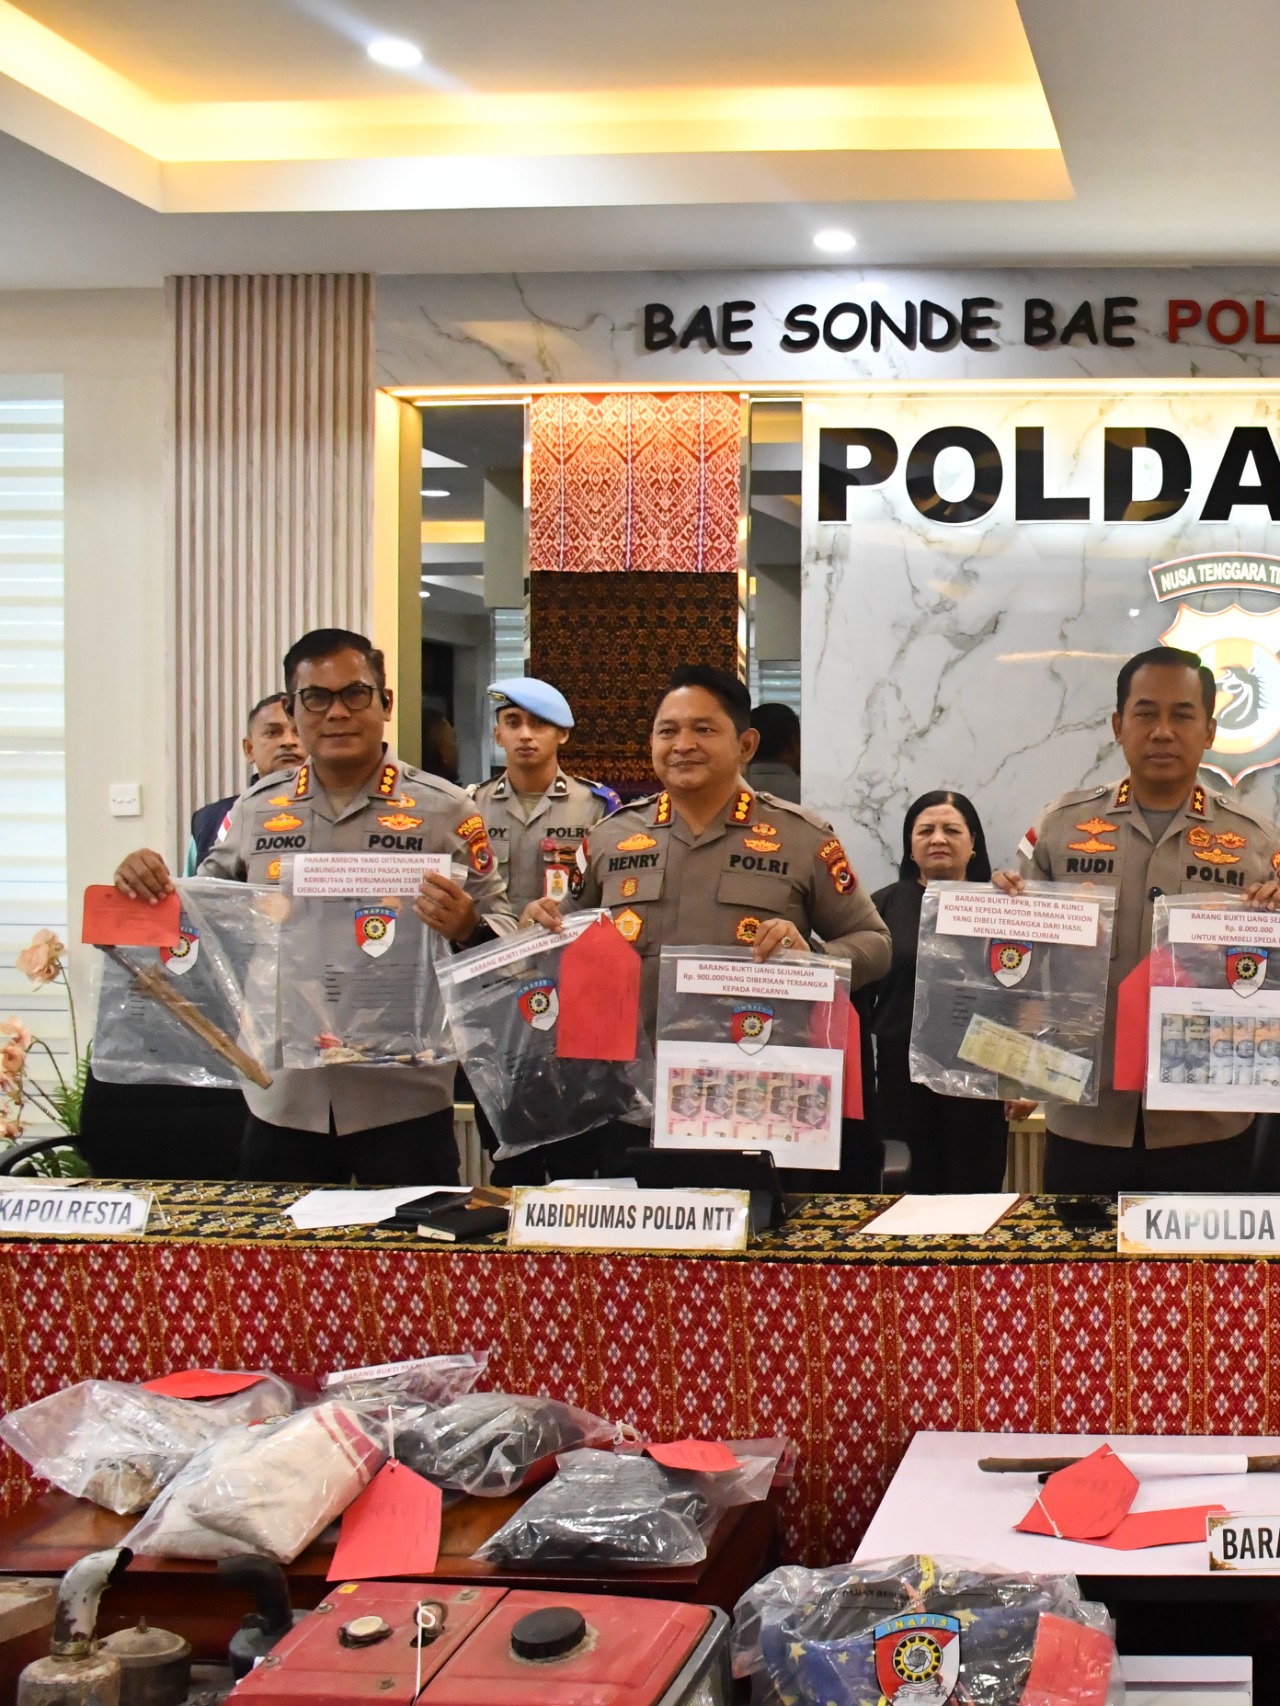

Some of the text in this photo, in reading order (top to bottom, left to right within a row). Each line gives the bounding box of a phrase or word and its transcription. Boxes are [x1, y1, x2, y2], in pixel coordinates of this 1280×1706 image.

[644, 300, 756, 350] BAE
[782, 297, 996, 351] SONDE
[1024, 297, 1138, 348] BAE
[1160, 566, 1197, 592] NUSA
[1197, 562, 1266, 583] TENGGARA
[488, 827, 507, 838] OY
[256, 835, 306, 850] DJOKO
[368, 835, 422, 851] POLRI
[608, 853, 660, 872] HENRY
[729, 854, 789, 875] POLRI
[1066, 857, 1114, 874] RUDI
[1186, 864, 1245, 887] POLRI
[955, 895, 986, 904] BARANG
[987, 897, 1009, 905] BUKTI
[1032, 900, 1052, 908] STNK
[1061, 903, 1084, 911] KUNCI
[944, 904, 973, 913] KONTAK
[975, 906, 1002, 915] SEPEDA
[1003, 909, 1031, 917] MOTOR
[1032, 911, 1065, 920] YAMAHA
[1191, 913, 1222, 921] BARANG
[1247, 915, 1268, 923] UANG
[952, 915, 1082, 932] YANG DIBELI TERSANGKA DARI HASIL
[973, 927, 1060, 940] MENJUAL EMAS CURIAN
[1218, 935, 1252, 943] MEMBELI
[1253, 936, 1277, 944] SPEDA
[470, 931, 579, 974] BARANG BUKTI PAKAIAN KORBAN
[699, 964, 815, 977] BARANG BUKTI UANG SEJUMLAH
[683, 973, 694, 981] Rp.
[746, 976, 784, 985] DIBERIKAN
[786, 979, 828, 988] TERSANGKA
[722, 986, 789, 996] KEPADA PACARNYA
[0, 1199, 131, 1226] KAPOLRESTA
[525, 1203, 735, 1232] KABIDHUMAS POLDA NTT
[1145, 1209, 1275, 1240] KAPOLDA
[887, 1617, 948, 1632] INAFIS
